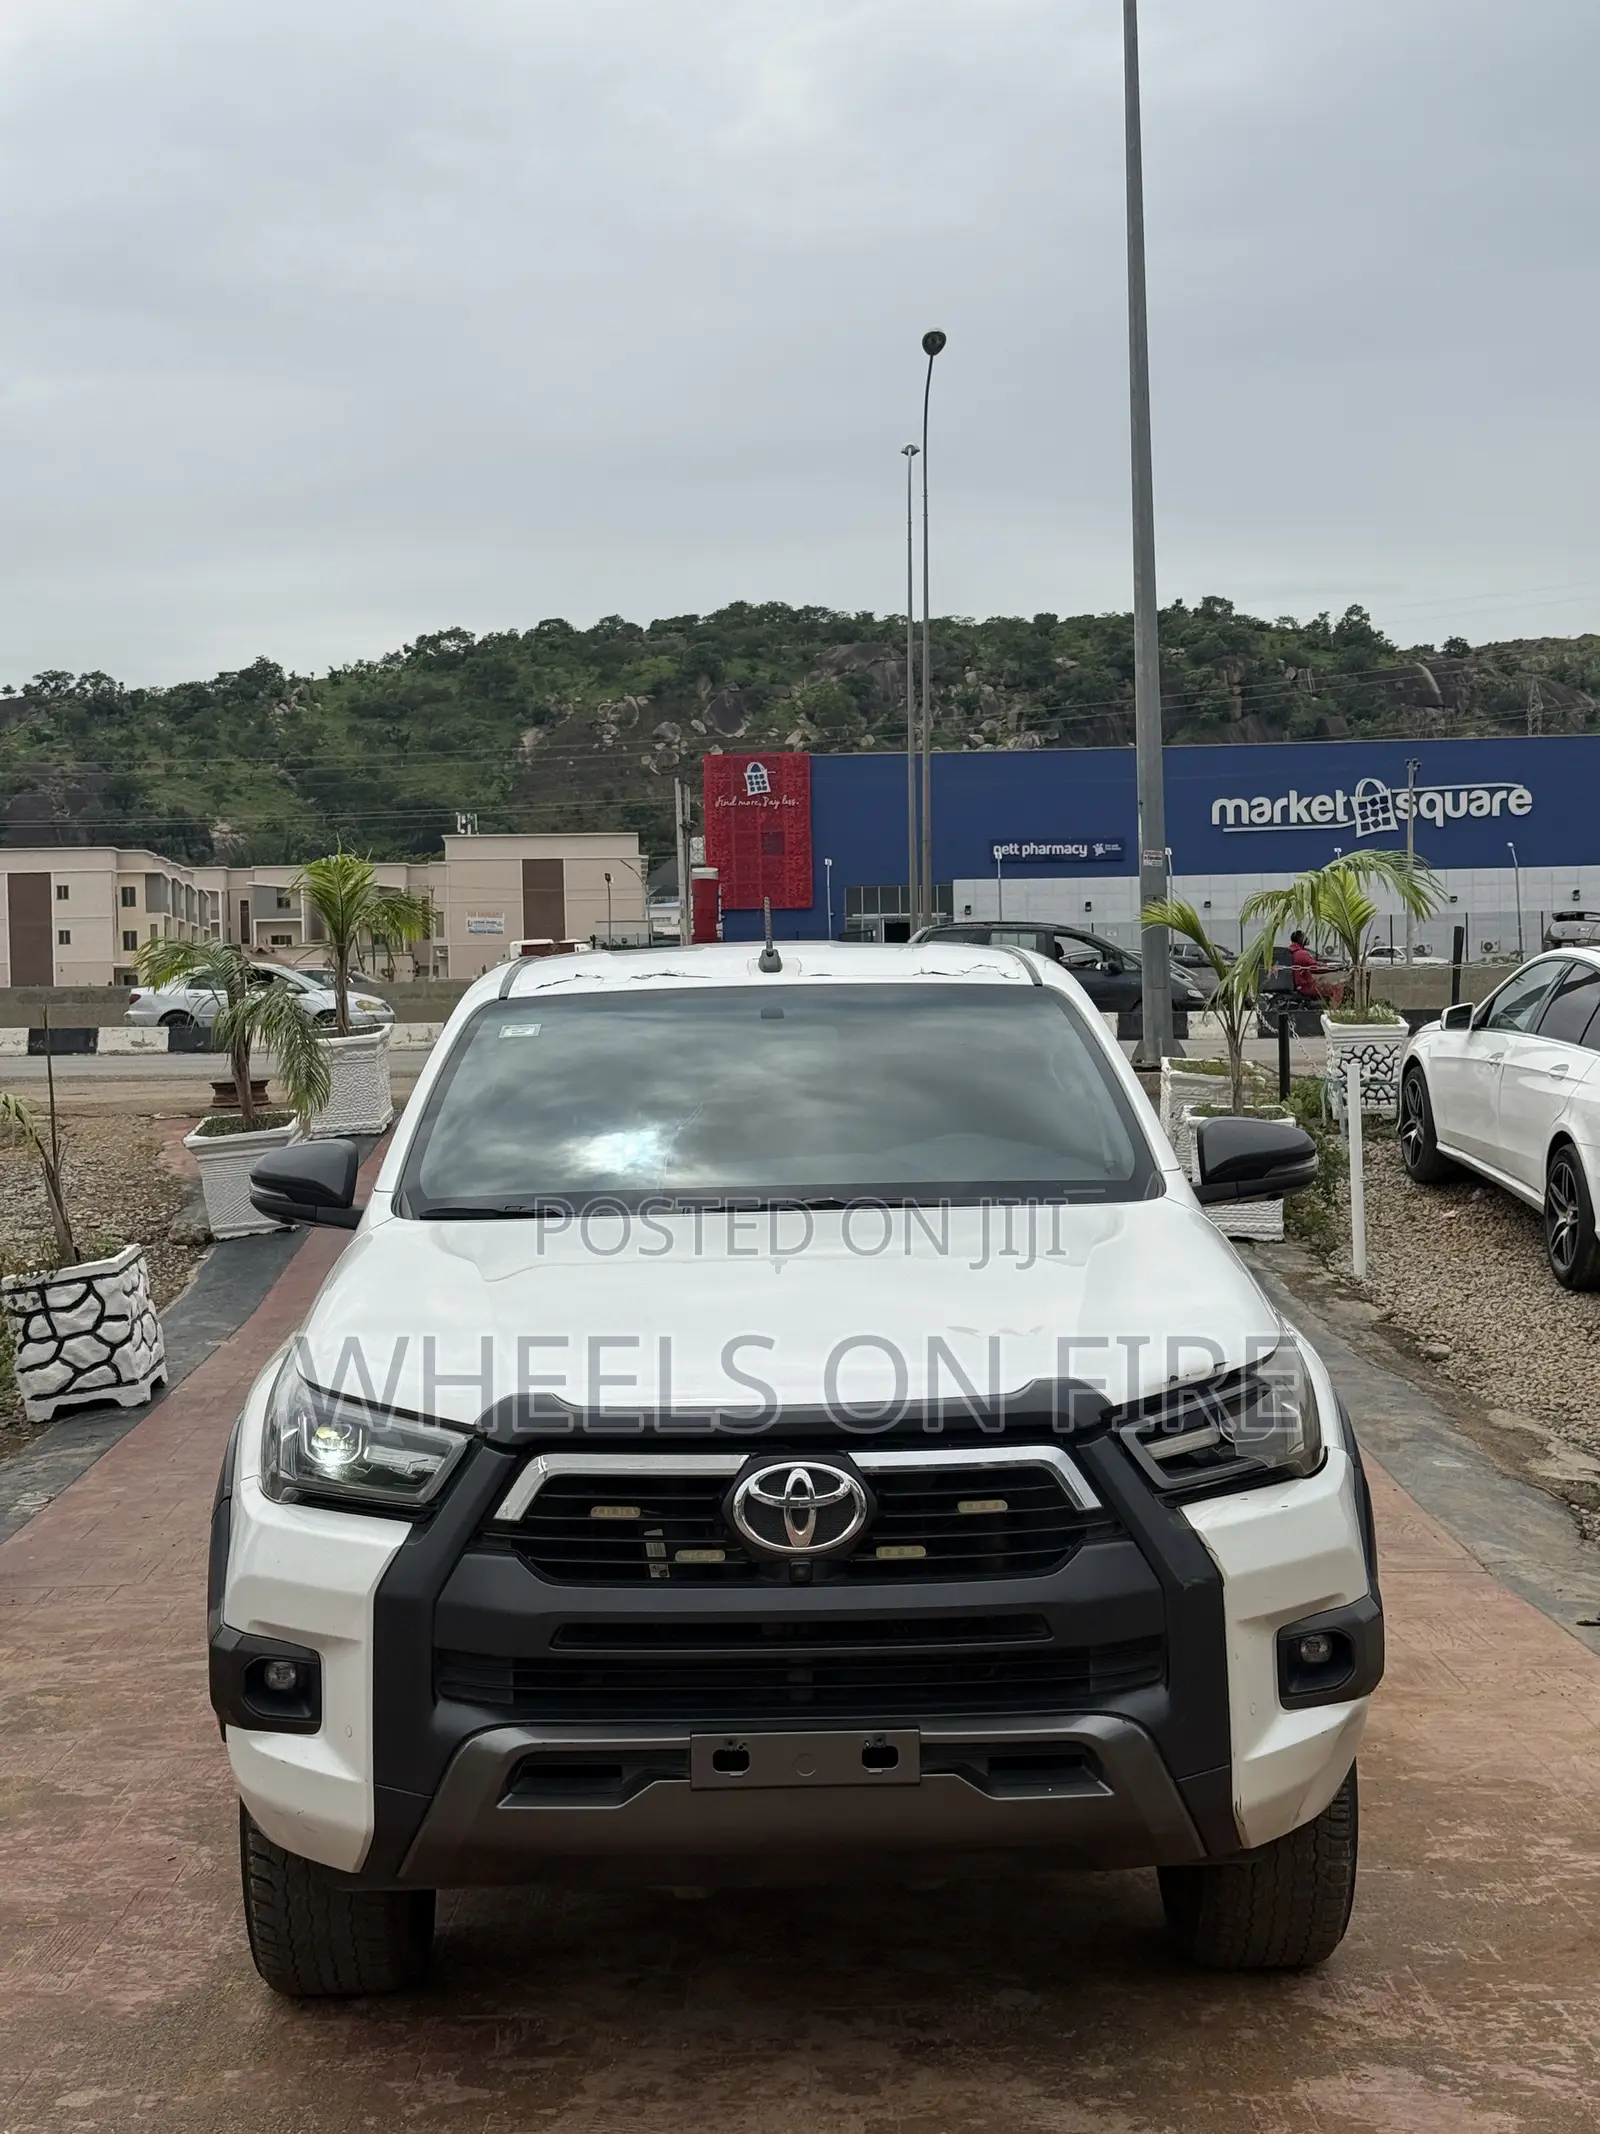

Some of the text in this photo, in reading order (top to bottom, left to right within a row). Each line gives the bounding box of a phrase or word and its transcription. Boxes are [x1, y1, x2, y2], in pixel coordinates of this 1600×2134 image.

[715, 795, 737, 808] Find
[762, 796, 781, 809] Pay
[1211, 788, 1533, 828] market square
[1022, 842, 1088, 858] pharmacy
